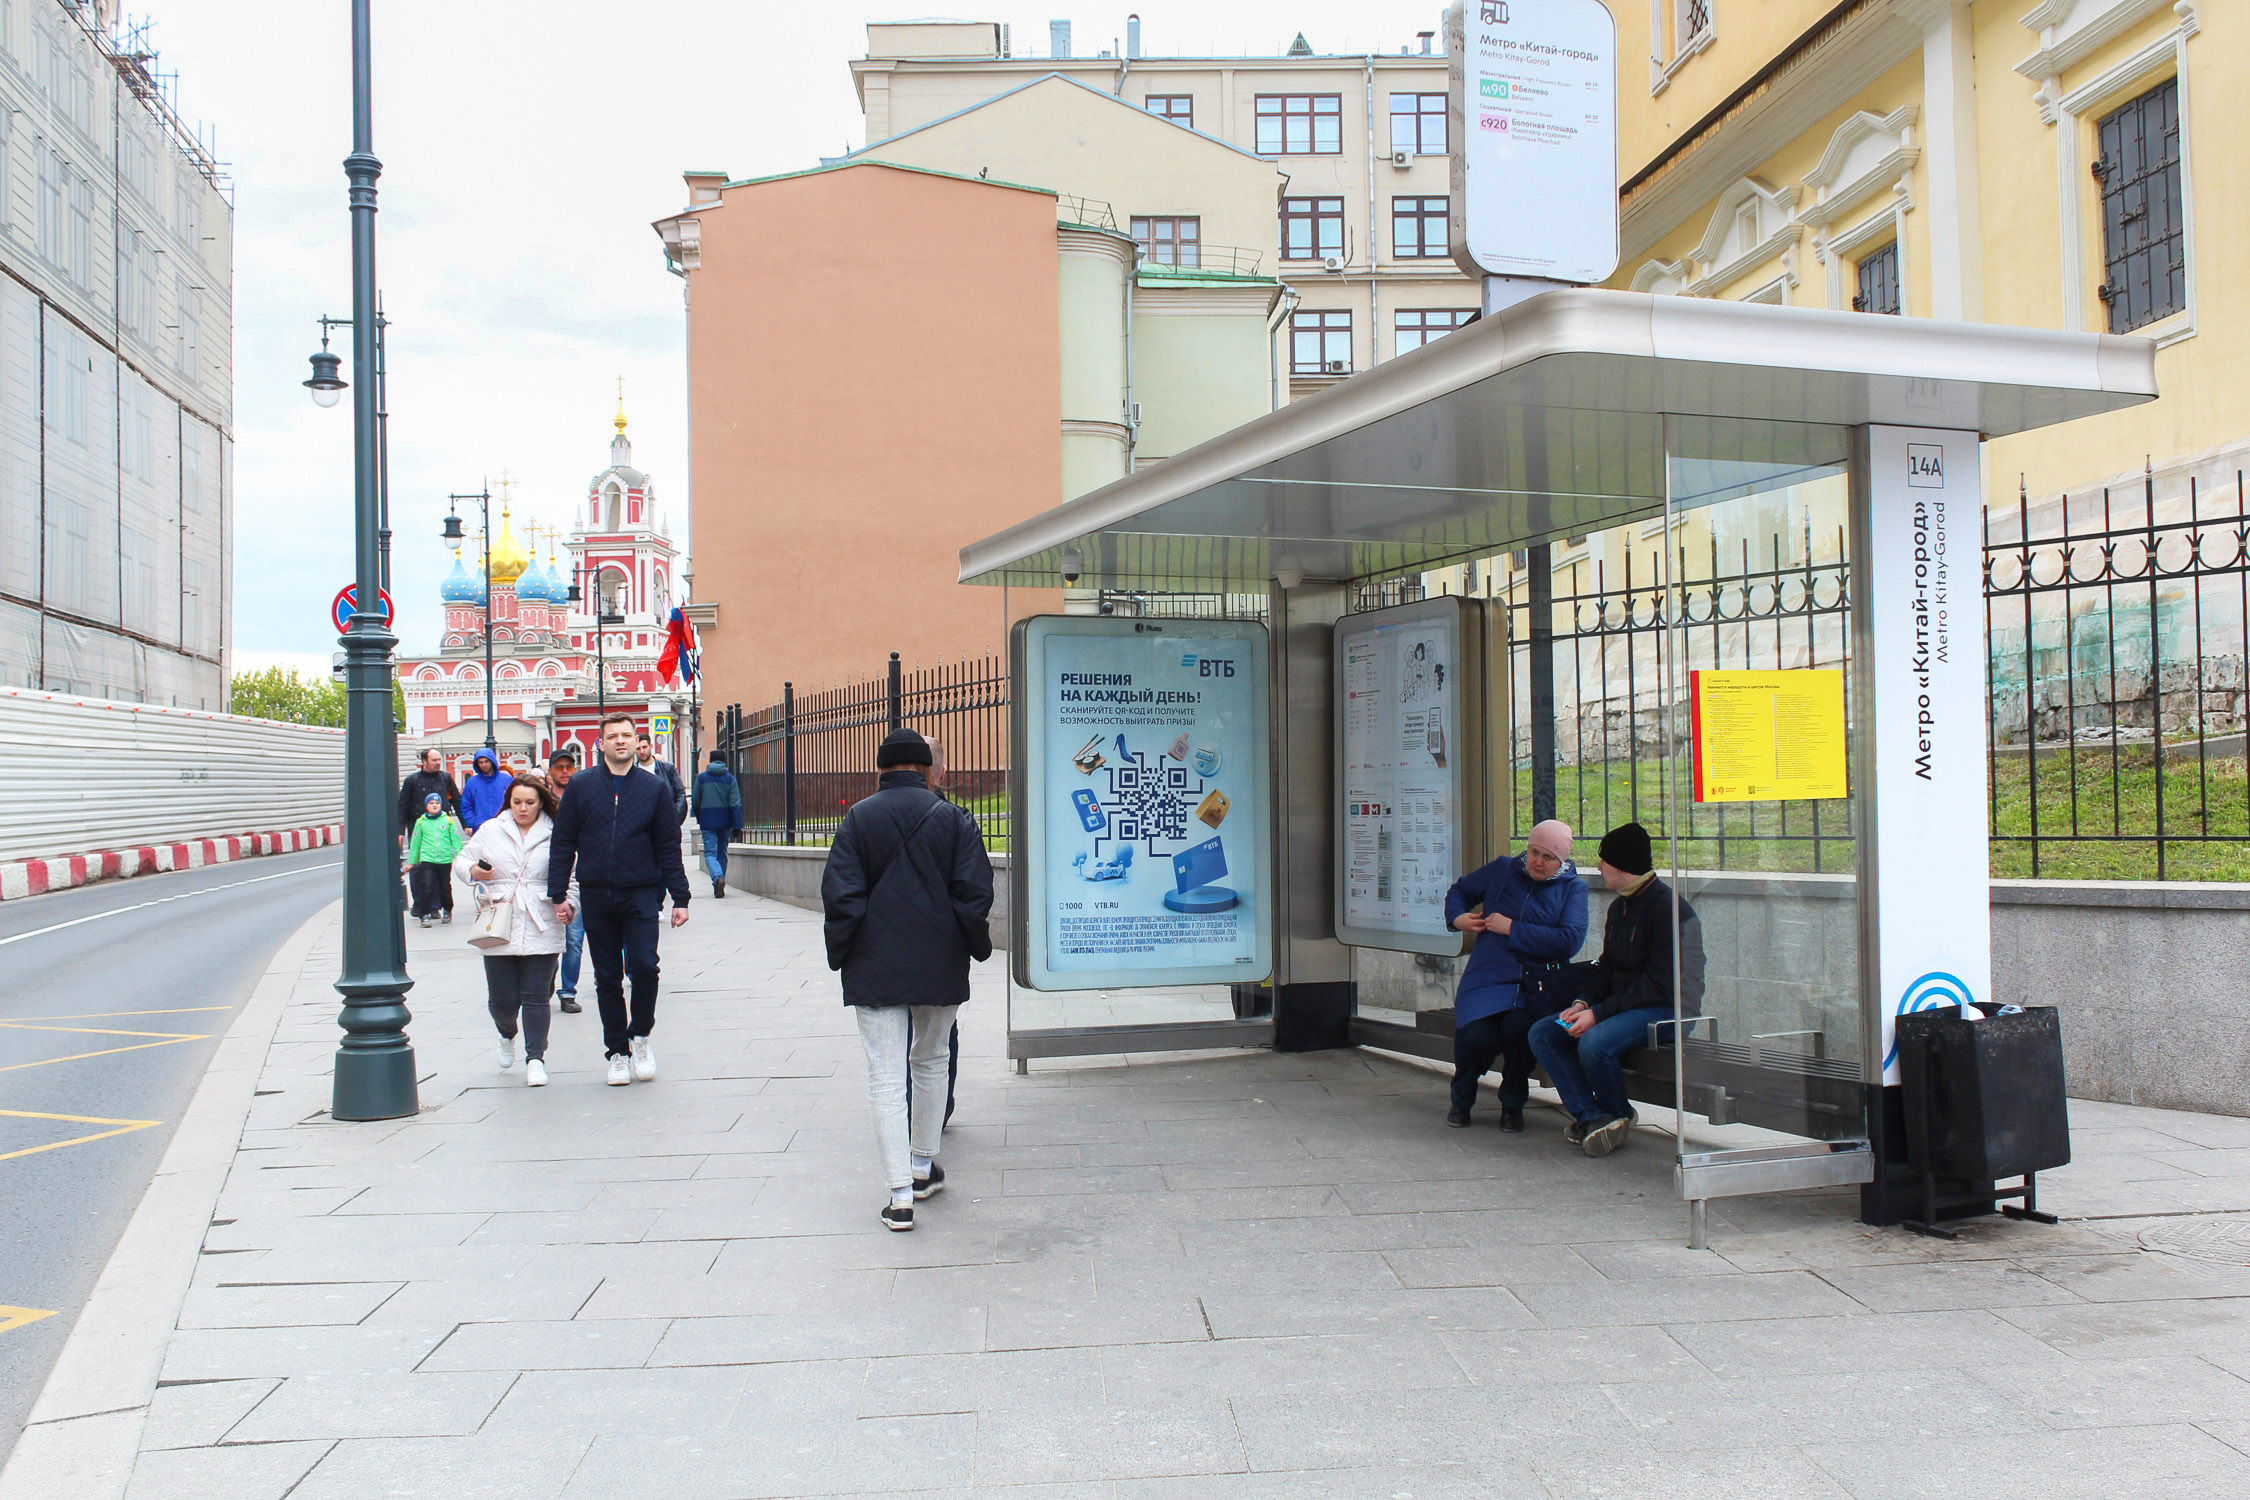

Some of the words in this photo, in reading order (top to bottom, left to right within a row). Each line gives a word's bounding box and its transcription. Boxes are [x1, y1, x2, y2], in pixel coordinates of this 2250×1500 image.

[1480, 34, 1517, 50] Метро
[1519, 41, 1599, 62] «Китай-город»
[1479, 49, 1503, 60] Metro
[1505, 53, 1550, 67] Kitay-Gorod
[1519, 85, 1549, 96] Беляево
[1481, 118, 1507, 130] с920
[1512, 119, 1545, 130] Болотная
[1547, 124, 1578, 135] площадь
[1933, 502, 1949, 605] Kitay-Gorod
[1911, 501, 1932, 689] «Китай-город»
[1936, 610, 1949, 663] Metro
[1199, 659, 1235, 678] ВТБ
[1061, 673, 1132, 686] РЕШЕНИЯ
[1061, 690, 1081, 701] НА
[1084, 688, 1154, 704] КАЖДЫЙ
[1156, 691, 1201, 705] ДЕНЬ!
[1060, 706, 1113, 714] СКАНИРУЙТЕ
[1115, 708, 1146, 716] QR-КОД
[1154, 708, 1195, 716] ПОЛУЧИТЕ
[1060, 717, 1124, 725] ВОЗМОЖНОСТЬ
[1125, 717, 1165, 726] ВЫИГРАТЬ
[1914, 694, 1935, 780] Метро
[1065, 902, 1083, 910] 1000
[1094, 902, 1119, 910] VTB.RU
